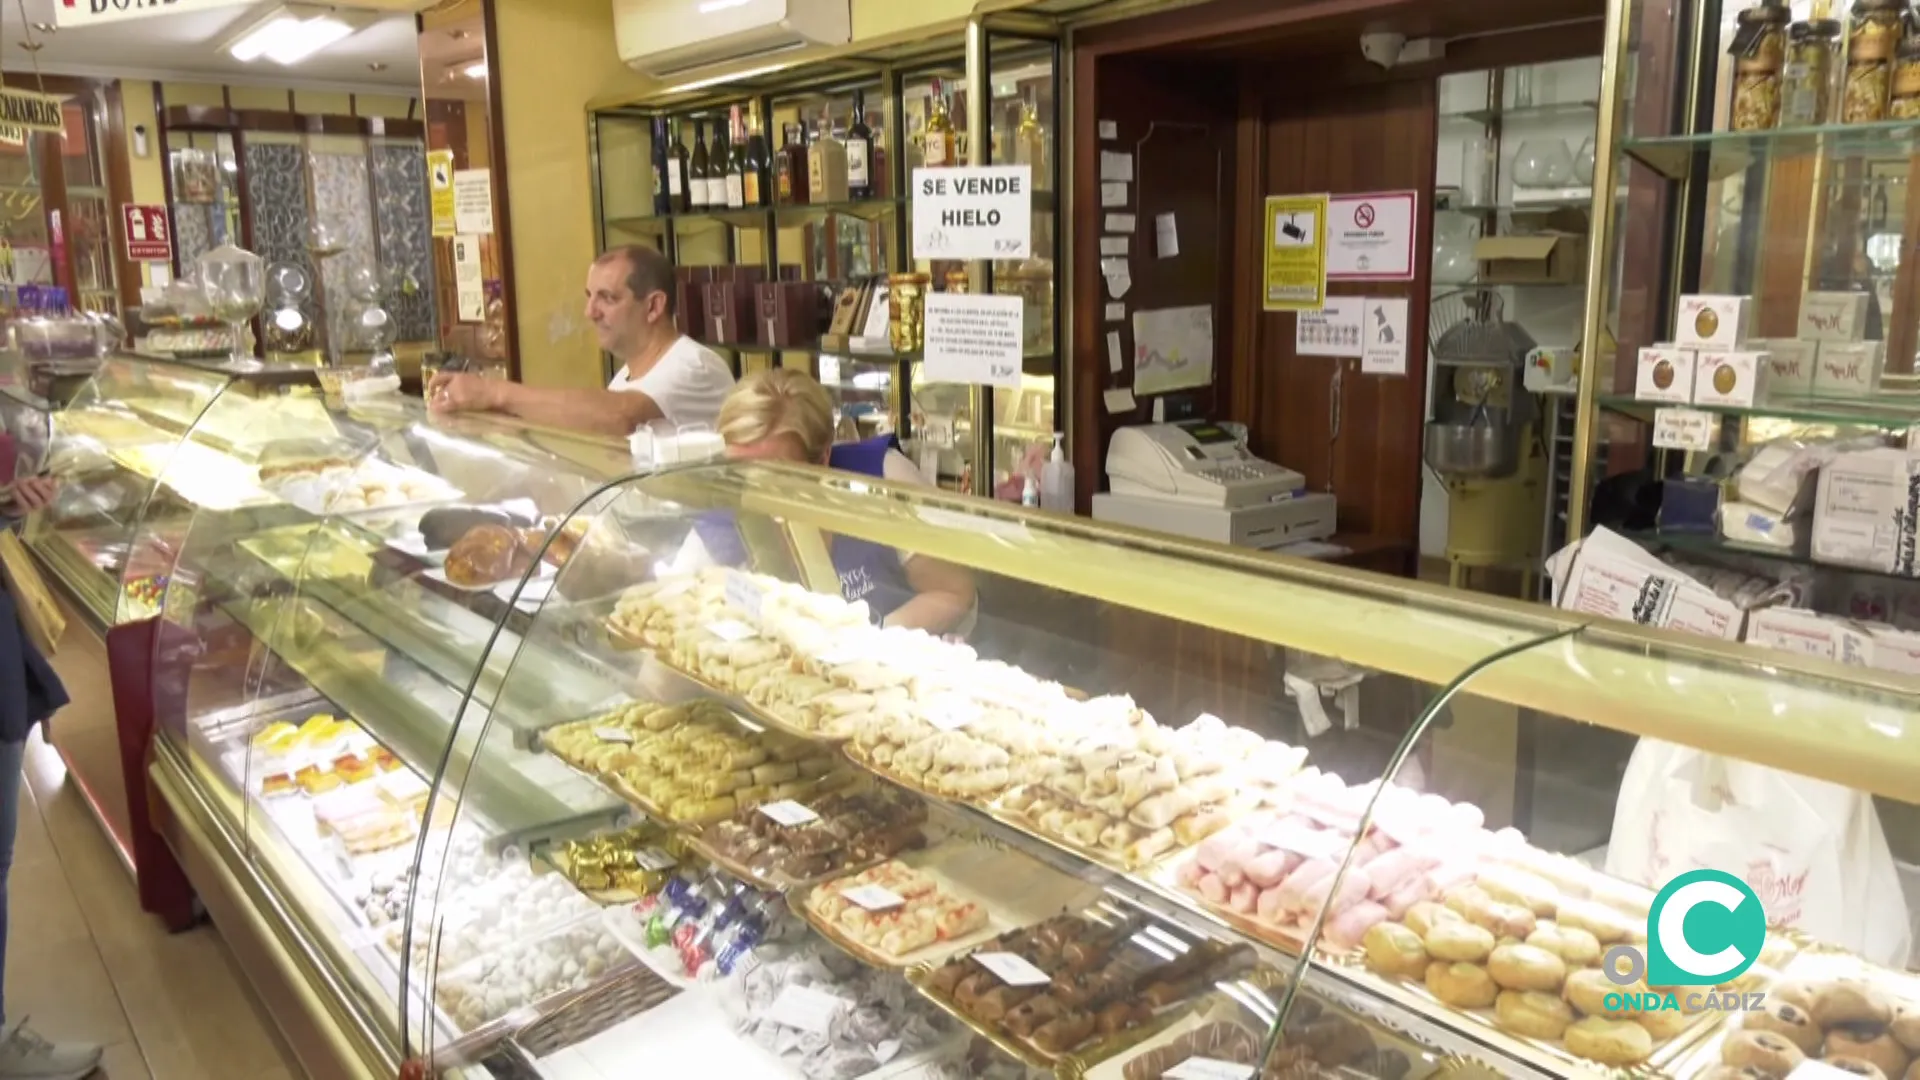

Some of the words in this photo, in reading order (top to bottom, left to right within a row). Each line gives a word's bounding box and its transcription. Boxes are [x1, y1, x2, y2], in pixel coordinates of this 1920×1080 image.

[922, 178, 946, 196] SE
[953, 176, 1021, 196] VENDE
[941, 208, 1001, 227] HIELO
